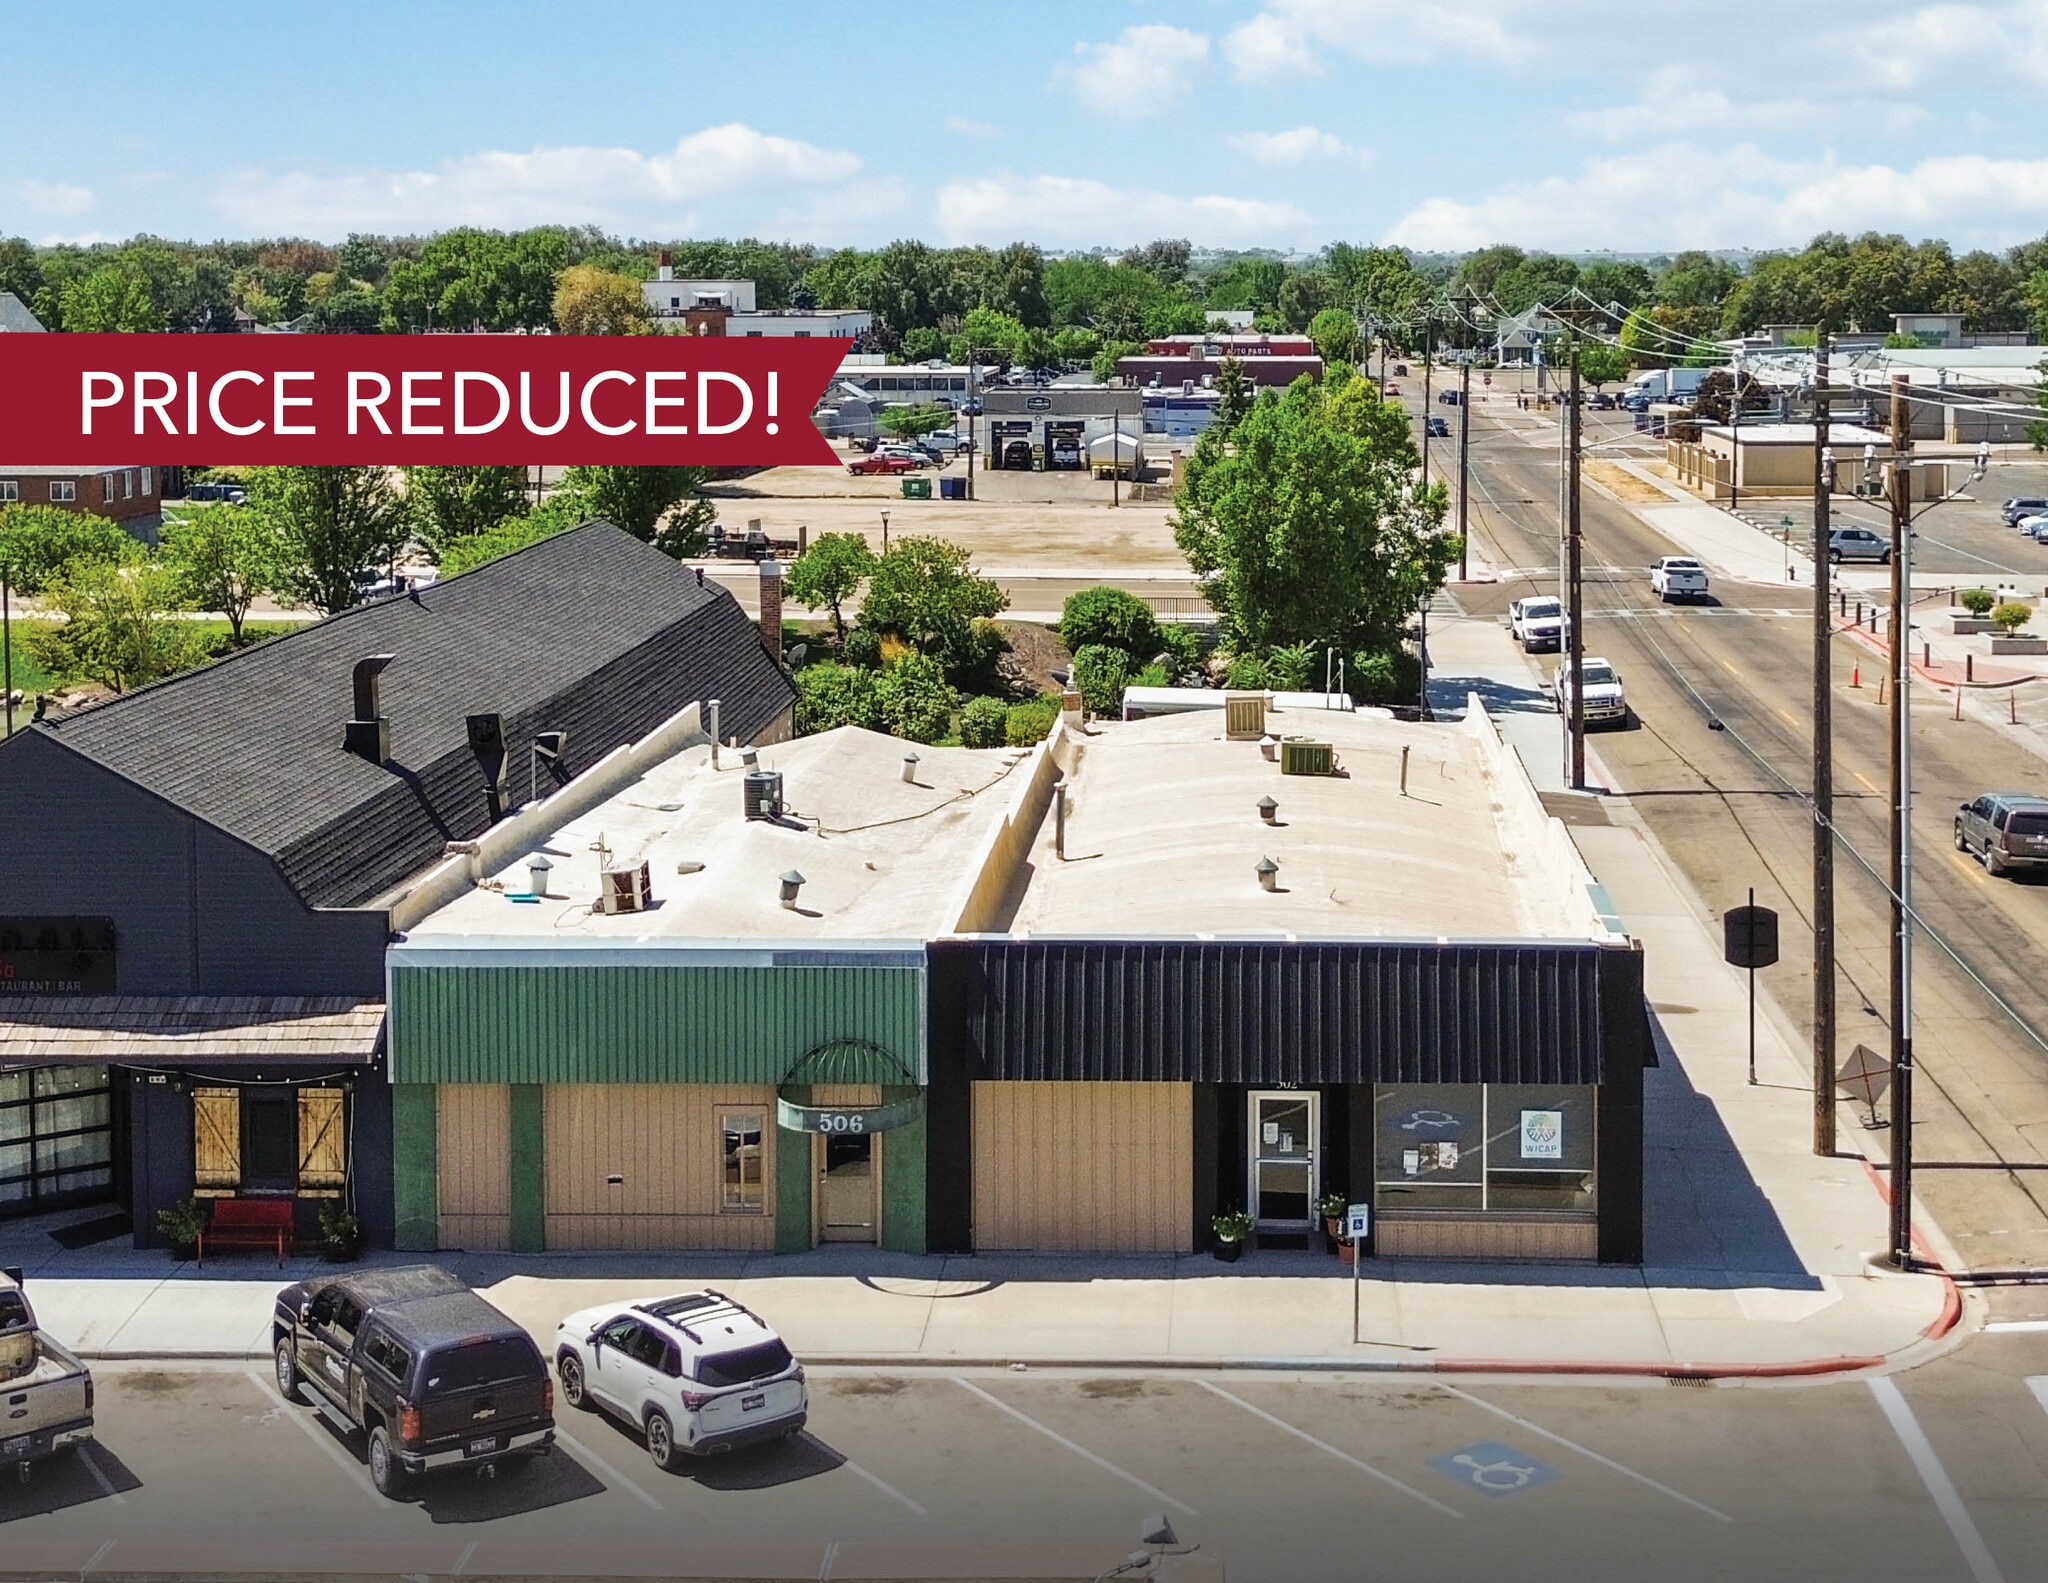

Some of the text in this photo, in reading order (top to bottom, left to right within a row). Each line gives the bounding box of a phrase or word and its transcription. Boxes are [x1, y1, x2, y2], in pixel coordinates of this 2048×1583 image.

[1226, 347, 1246, 356] AUTO
[1248, 347, 1272, 356] PARTS
[58, 980, 82, 991] BAR
[819, 1113, 864, 1133] 506
[1525, 1144, 1557, 1153] WICAP
